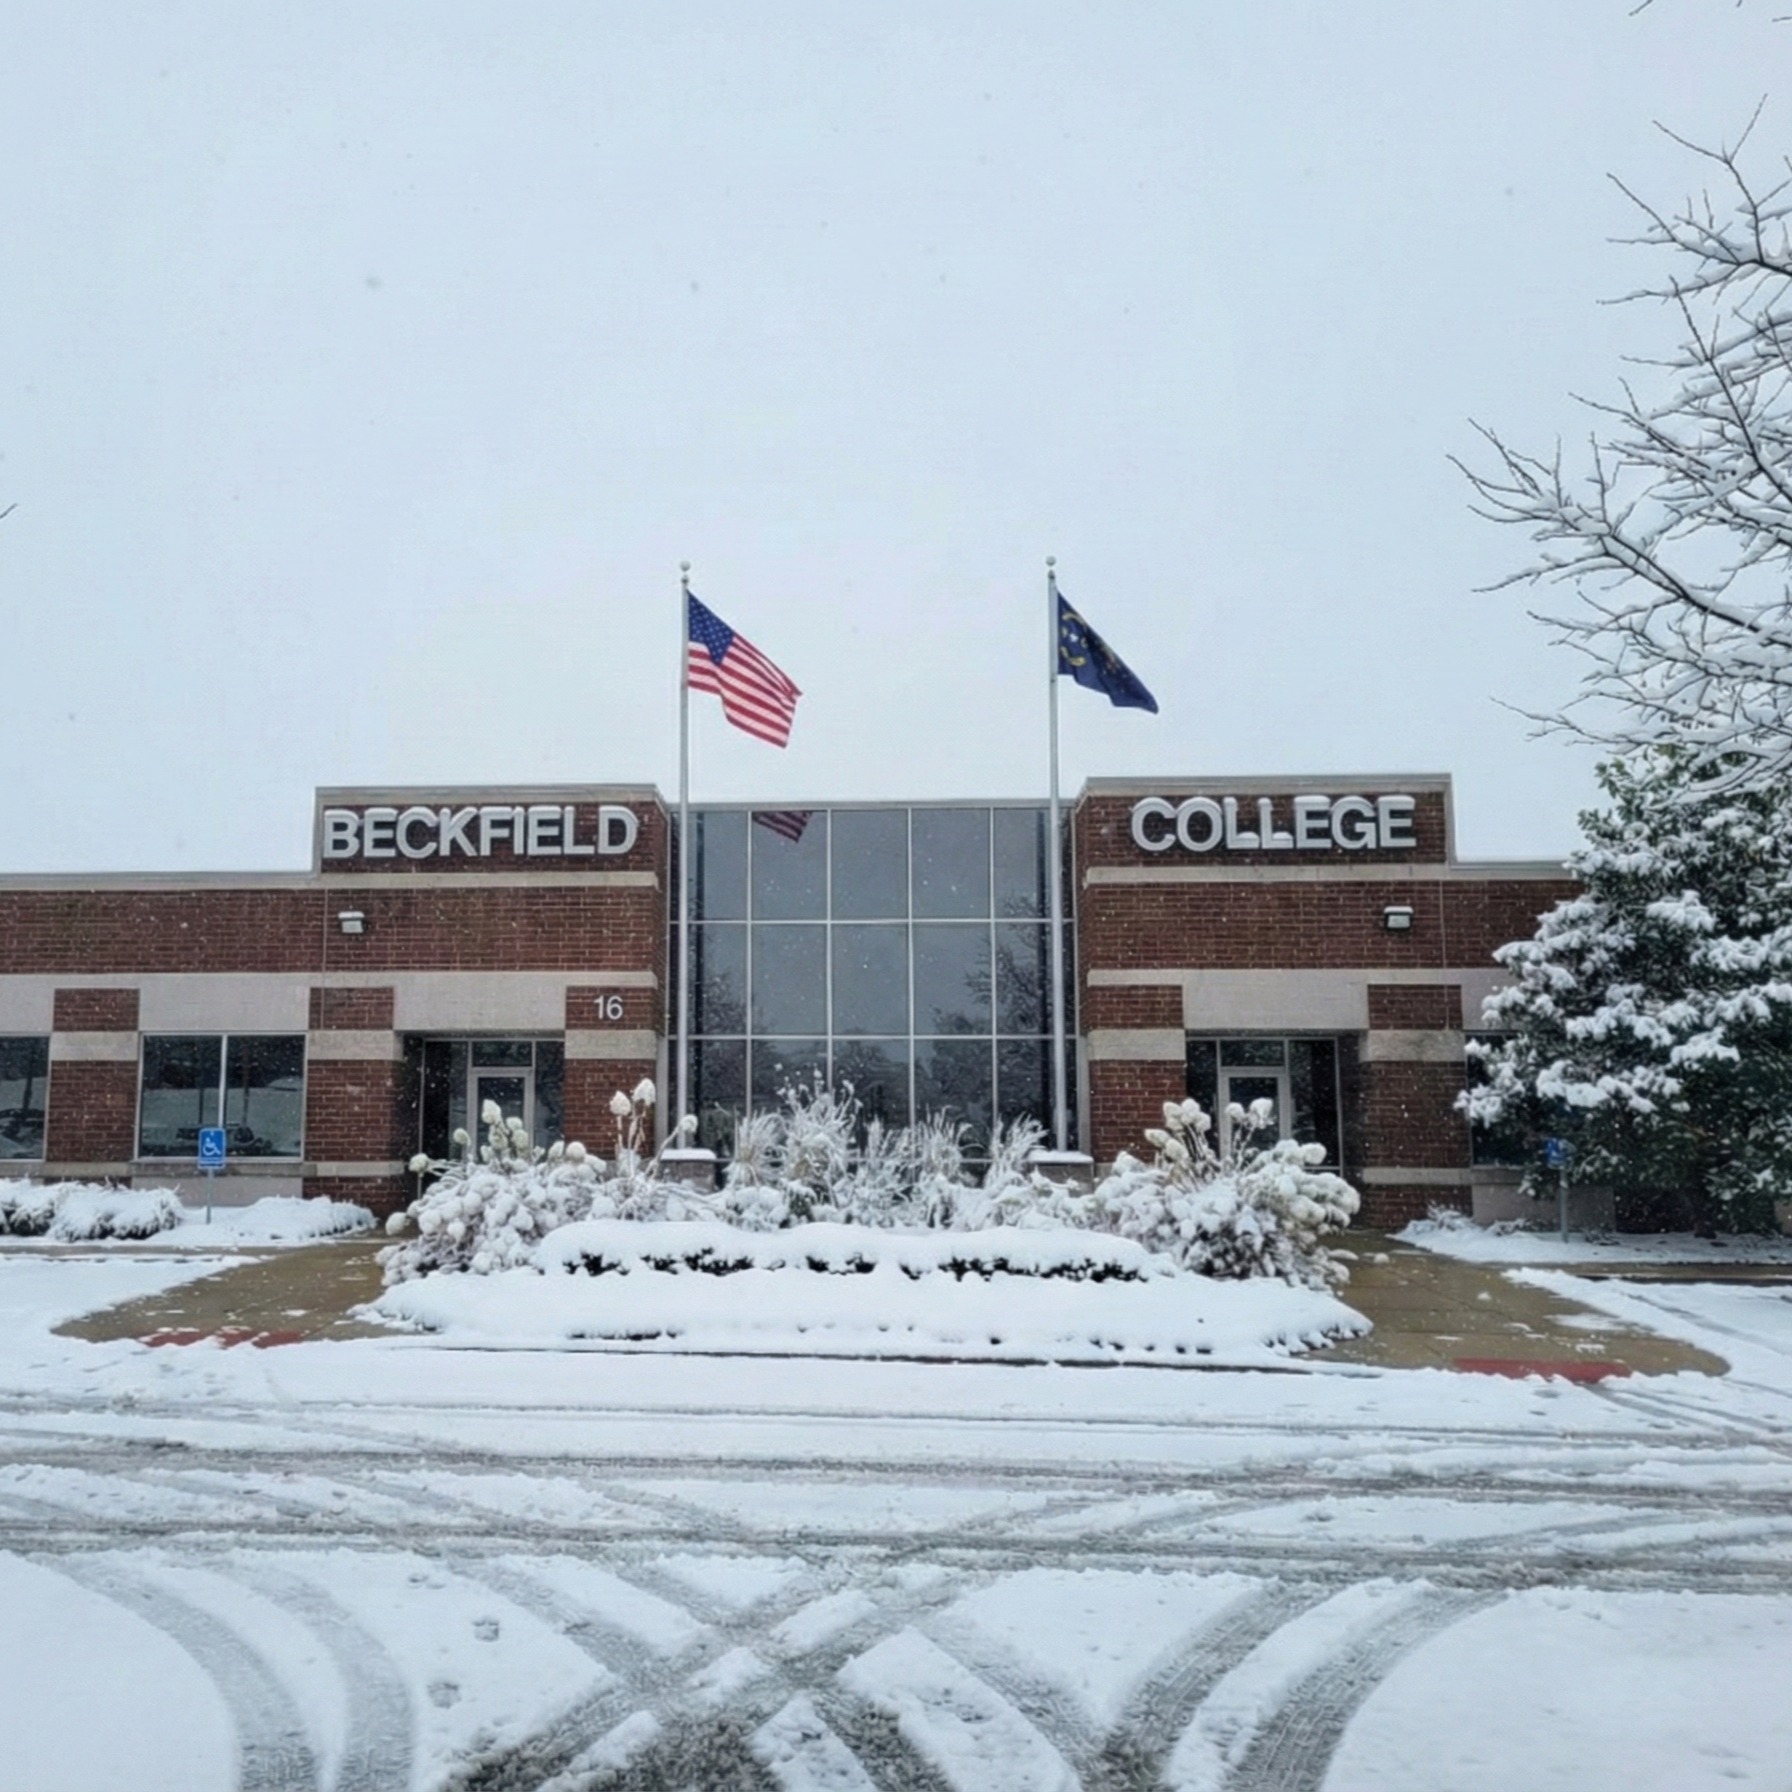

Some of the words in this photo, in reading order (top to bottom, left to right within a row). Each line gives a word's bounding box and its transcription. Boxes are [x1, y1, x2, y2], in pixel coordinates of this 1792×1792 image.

[323, 806, 639, 859] BECKFIELD
[1130, 795, 1417, 851] COLLEGE
[594, 995, 624, 1020] 16
